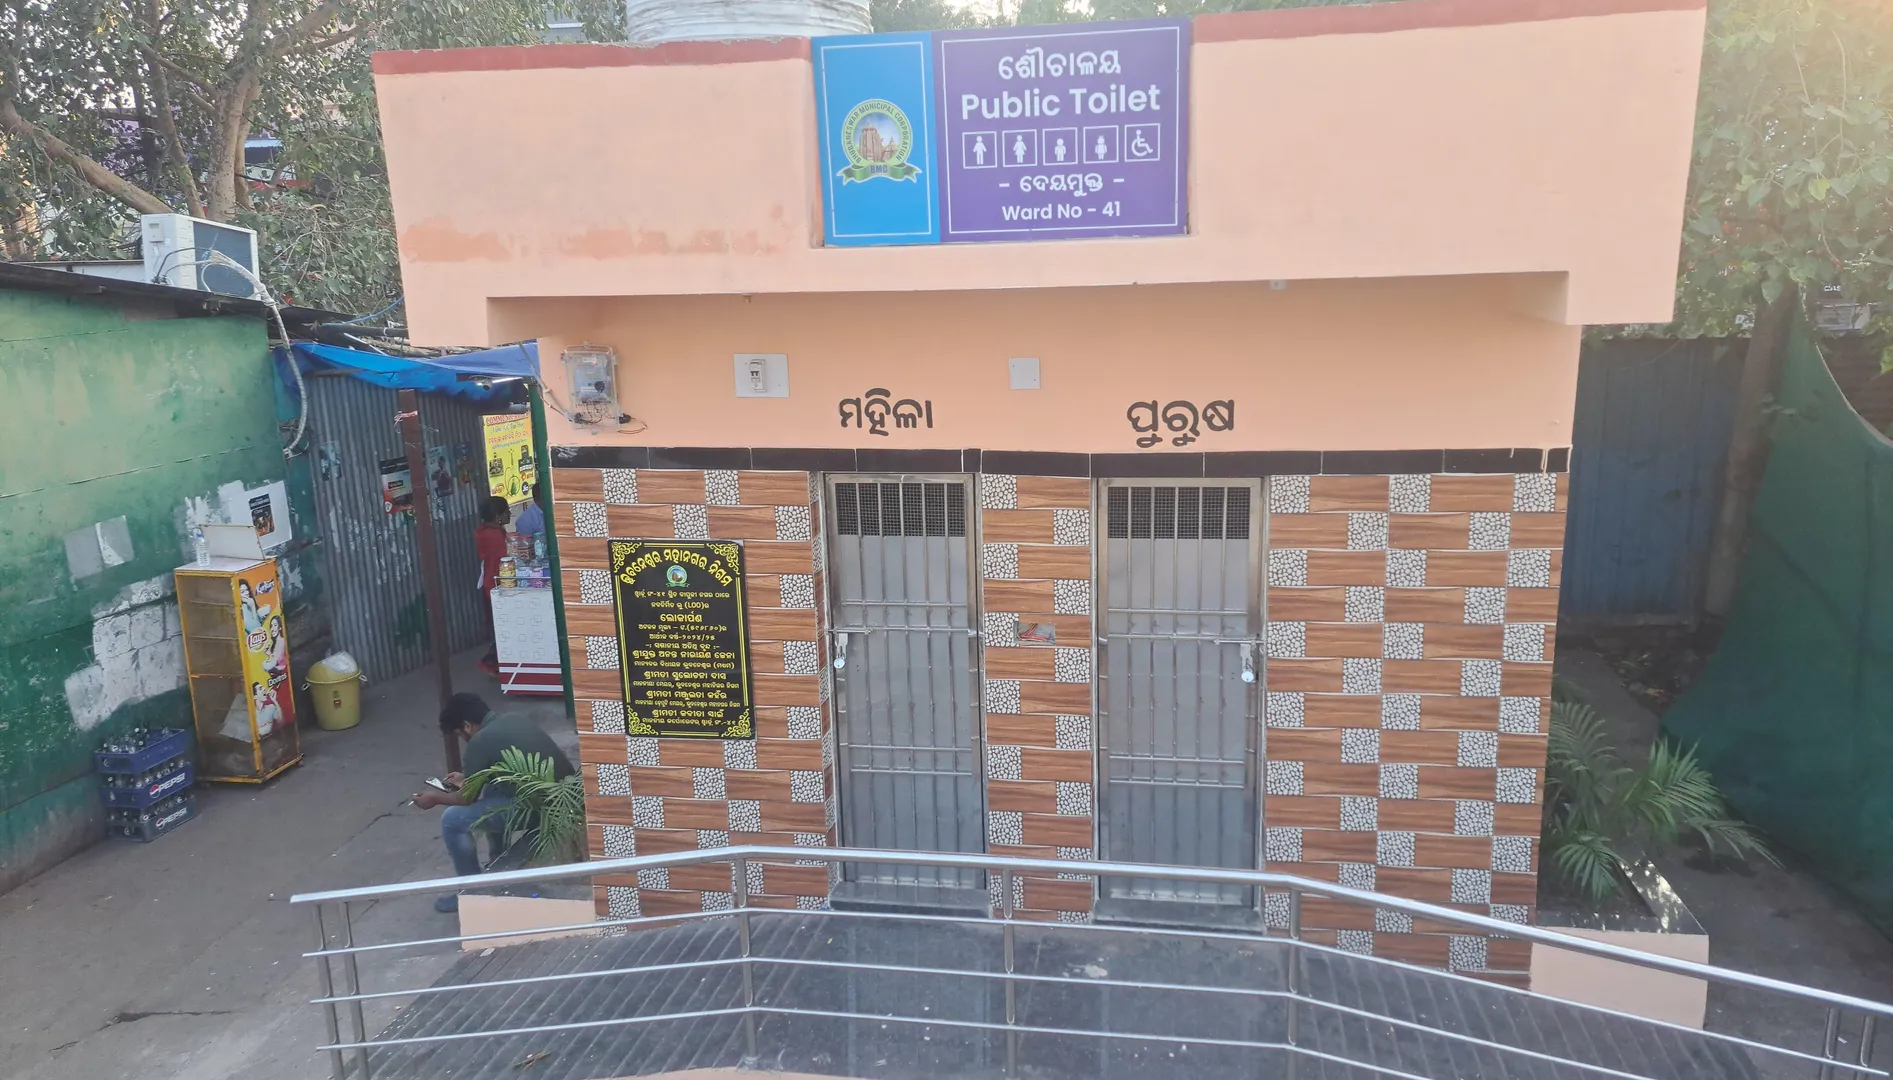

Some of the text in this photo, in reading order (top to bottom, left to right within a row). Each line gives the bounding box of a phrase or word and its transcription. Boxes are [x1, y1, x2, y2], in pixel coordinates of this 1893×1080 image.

[998, 47, 1121, 79] ଶୌଚାଳୟ
[962, 84, 1160, 119] Public Toilet
[846, 103, 908, 163] BHUBANESWAR MUNICIPAL CORPORATION
[1020, 172, 1103, 197] ଦେୟମୁକ୍ତ
[1002, 203, 1052, 221] Ward
[1057, 204, 1082, 219] No
[1102, 201, 1121, 217] 41
[839, 387, 933, 436] ମହିଳା
[1127, 399, 1235, 448] ପୁରୁଷ
[664, 549, 708, 570] ମହାନଗର
[708, 560, 733, 587] ନିଗମ
[660, 611, 702, 623] ଲୋକାର୍ପଣ
[644, 671, 669, 679] ଶ୍ରୀମତୀ
[672, 672, 707, 681] ସୁଲୋଚନା
[646, 690, 671, 699] ଶ୍ରୀମତୀ
[652, 709, 677, 718] ଶ୍ରୀମତୀ
[159, 773, 186, 792] PEPSI
[164, 807, 187, 825] PEPSI
